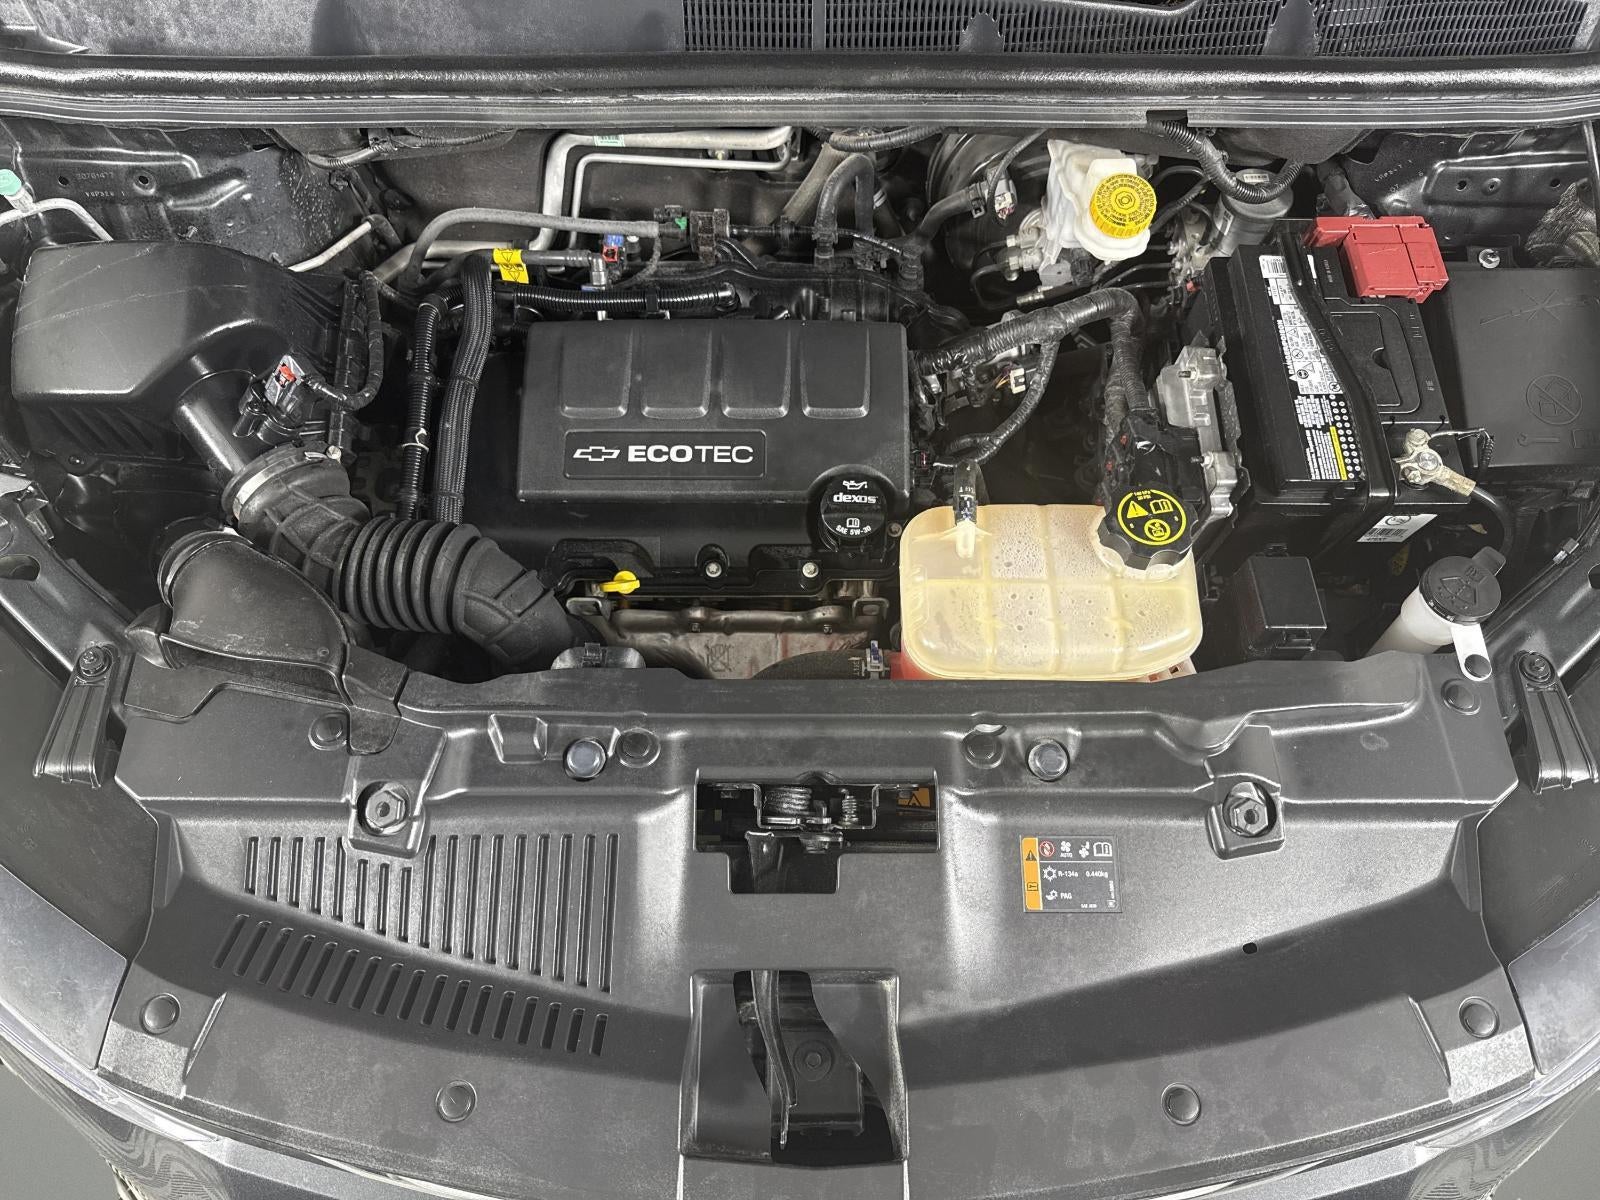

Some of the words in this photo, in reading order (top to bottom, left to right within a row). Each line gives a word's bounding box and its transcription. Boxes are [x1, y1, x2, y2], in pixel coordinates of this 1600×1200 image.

[628, 445, 753, 463] ECOTEC
[833, 492, 877, 504] dexos
[836, 524, 848, 535] SAE
[850, 525, 871, 536] 5W-30
